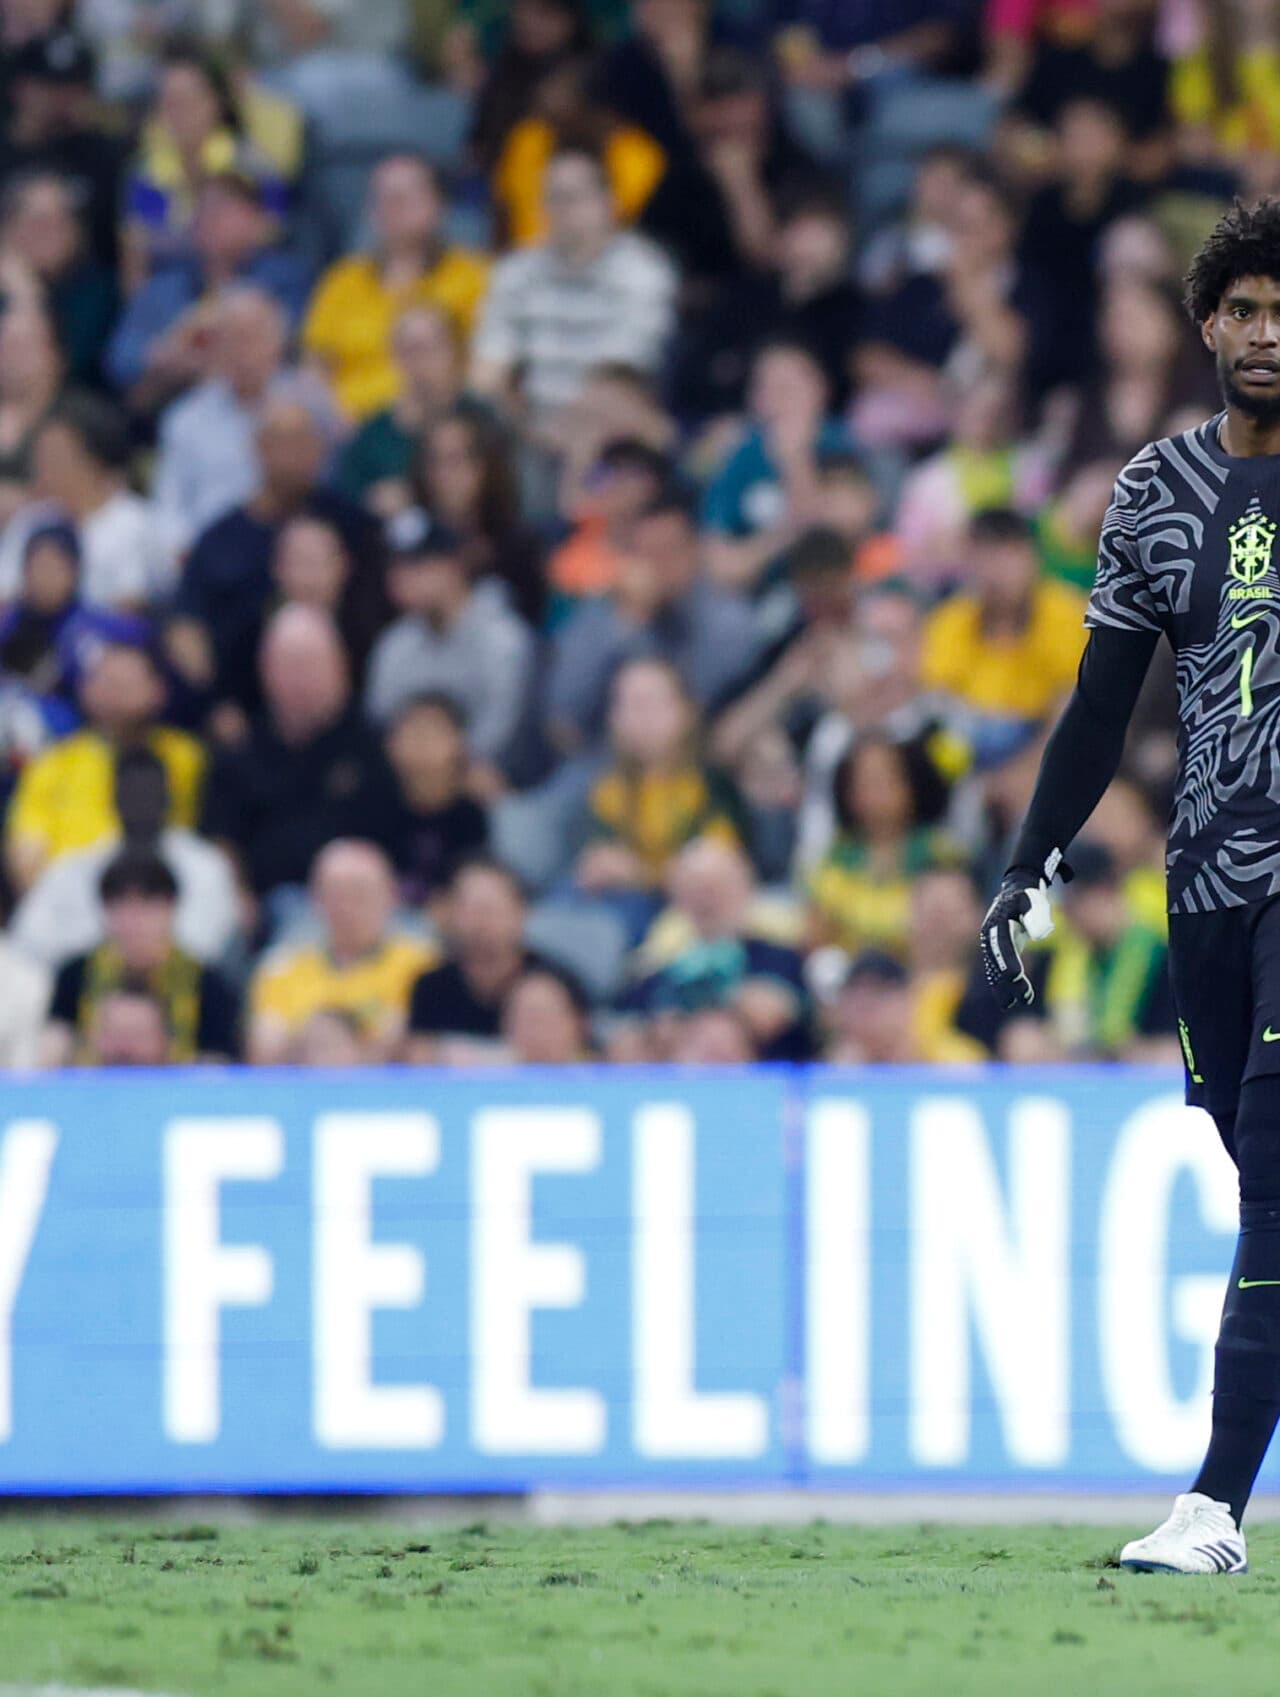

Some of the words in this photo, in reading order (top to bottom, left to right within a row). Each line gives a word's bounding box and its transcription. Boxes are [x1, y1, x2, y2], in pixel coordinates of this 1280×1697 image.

[1229, 587, 1273, 599] BRASIL
[1239, 647, 1254, 717] 1
[163, 1093, 1240, 1475] FEELING
